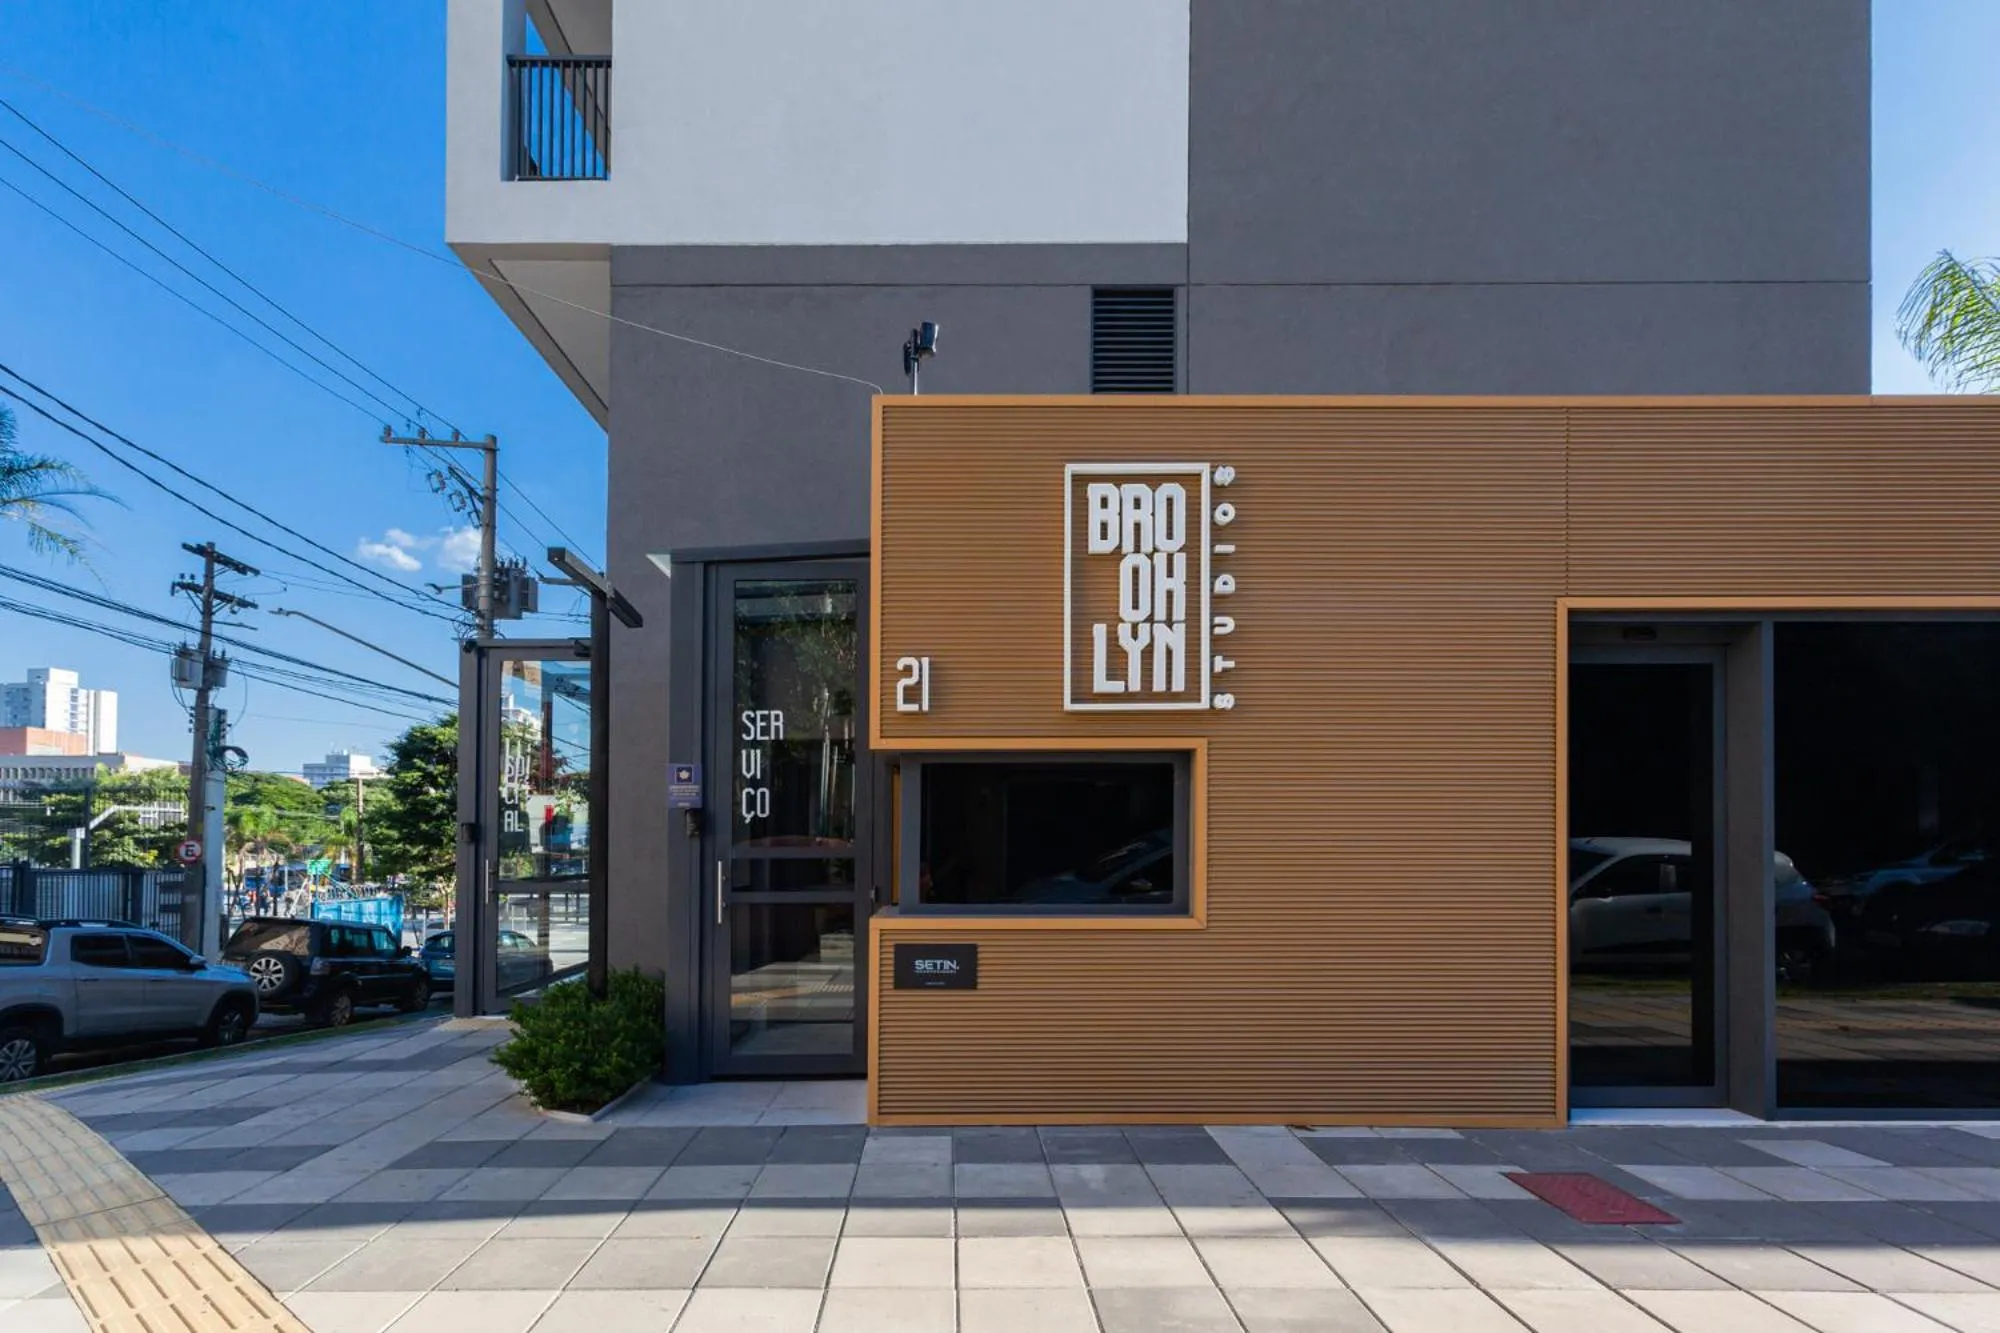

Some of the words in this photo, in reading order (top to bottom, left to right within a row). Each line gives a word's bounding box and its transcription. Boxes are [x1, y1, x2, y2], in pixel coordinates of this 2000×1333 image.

[1087, 483, 1186, 554] BRO
[1213, 465, 1236, 711] STUDIOS
[896, 656, 929, 712] 21
[1092, 622, 1186, 693] LYN
[741, 710, 784, 741] SER
[504, 810, 524, 833] AL
[741, 787, 770, 824] ÇO
